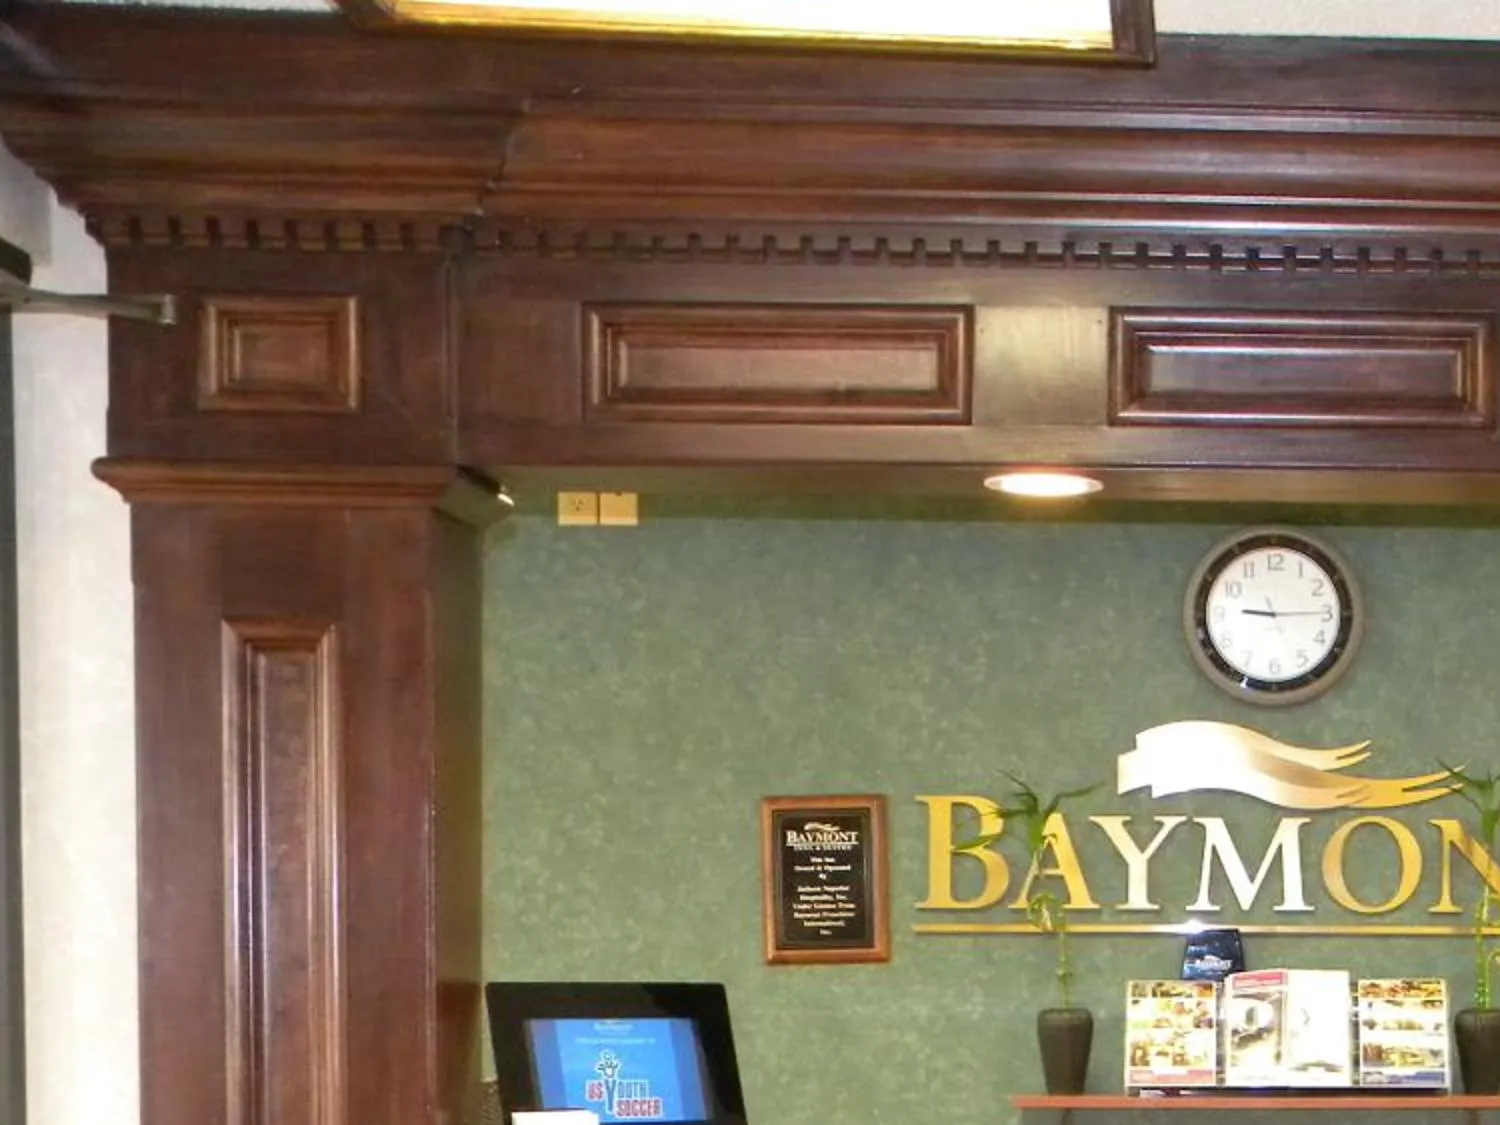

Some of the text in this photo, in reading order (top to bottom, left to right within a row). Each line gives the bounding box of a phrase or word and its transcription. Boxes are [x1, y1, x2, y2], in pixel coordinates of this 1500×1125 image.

[1243, 560, 1255, 579] 11
[1266, 553, 1286, 572] 12
[1297, 561, 1304, 579] 1
[1225, 579, 1243, 599] 10
[1310, 578, 1325, 597] 2
[1320, 603, 1334, 623] 3
[1312, 629, 1326, 646] 4
[786, 830, 859, 843] BAYMONT
